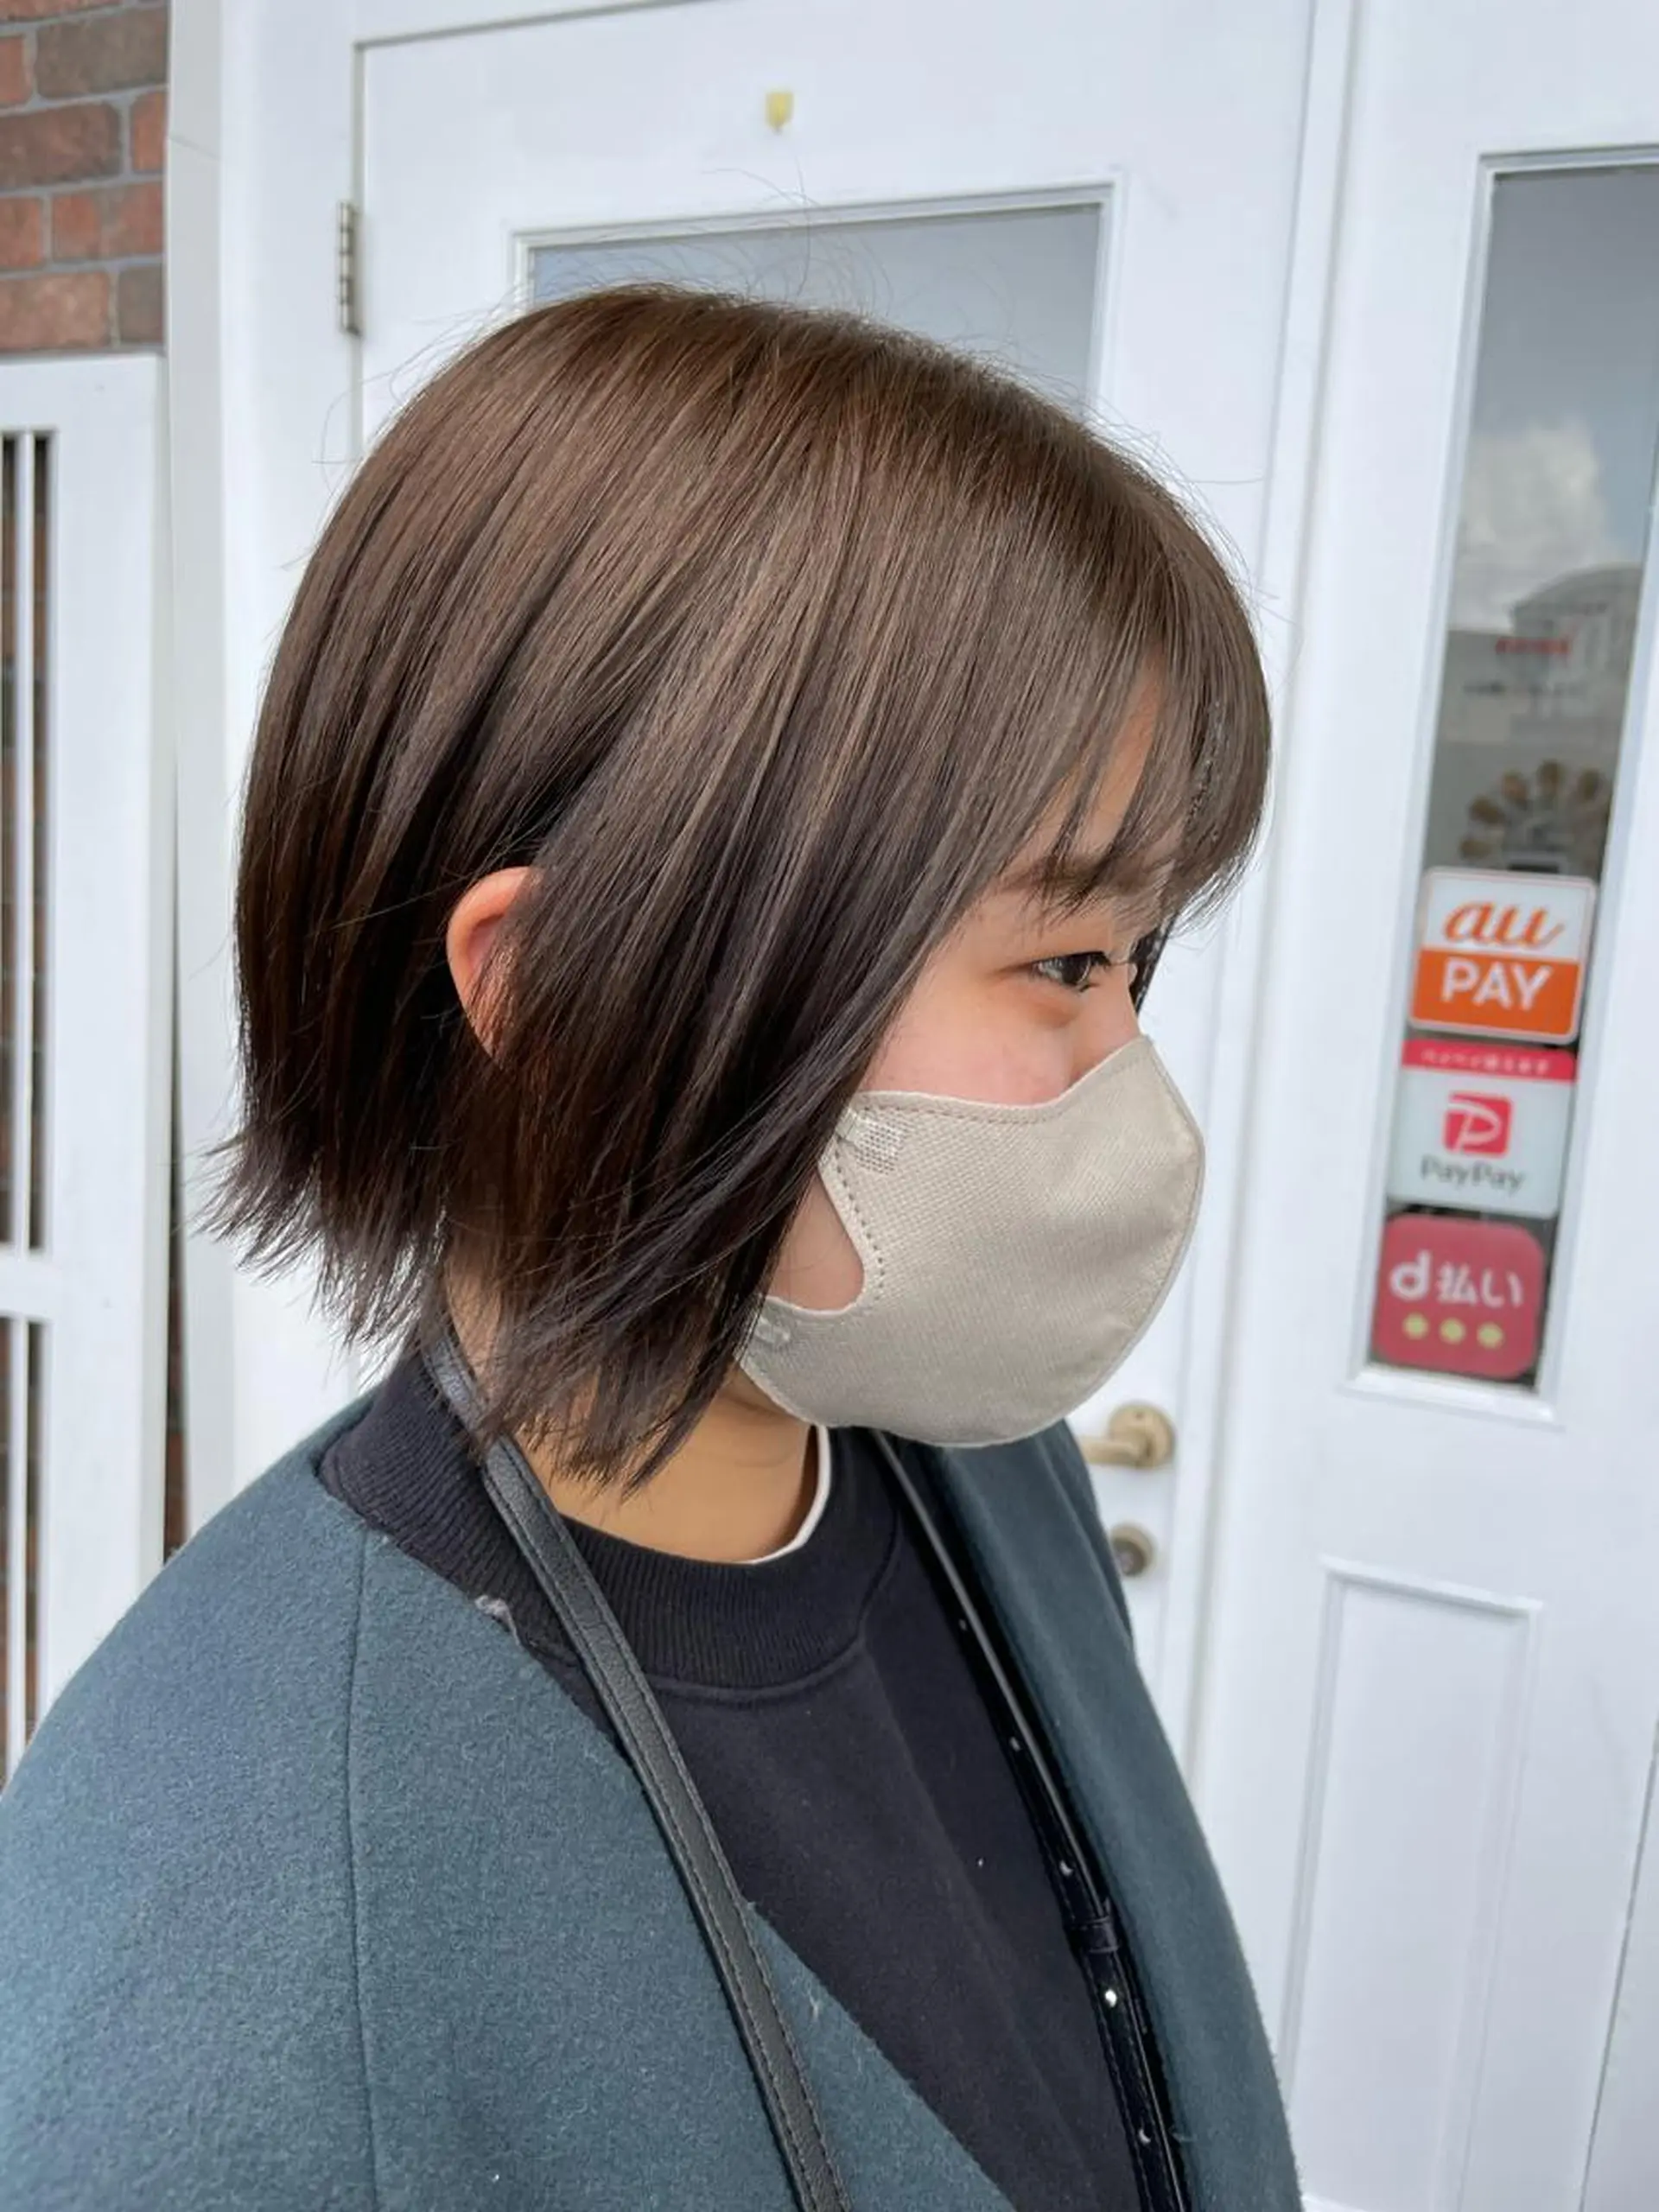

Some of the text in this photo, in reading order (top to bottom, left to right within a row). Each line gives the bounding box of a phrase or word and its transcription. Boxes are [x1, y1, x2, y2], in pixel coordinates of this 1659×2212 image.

[1442, 901, 1566, 949] au
[1441, 956, 1552, 1012] PAY
[1420, 1154, 1525, 1198] PayPay
